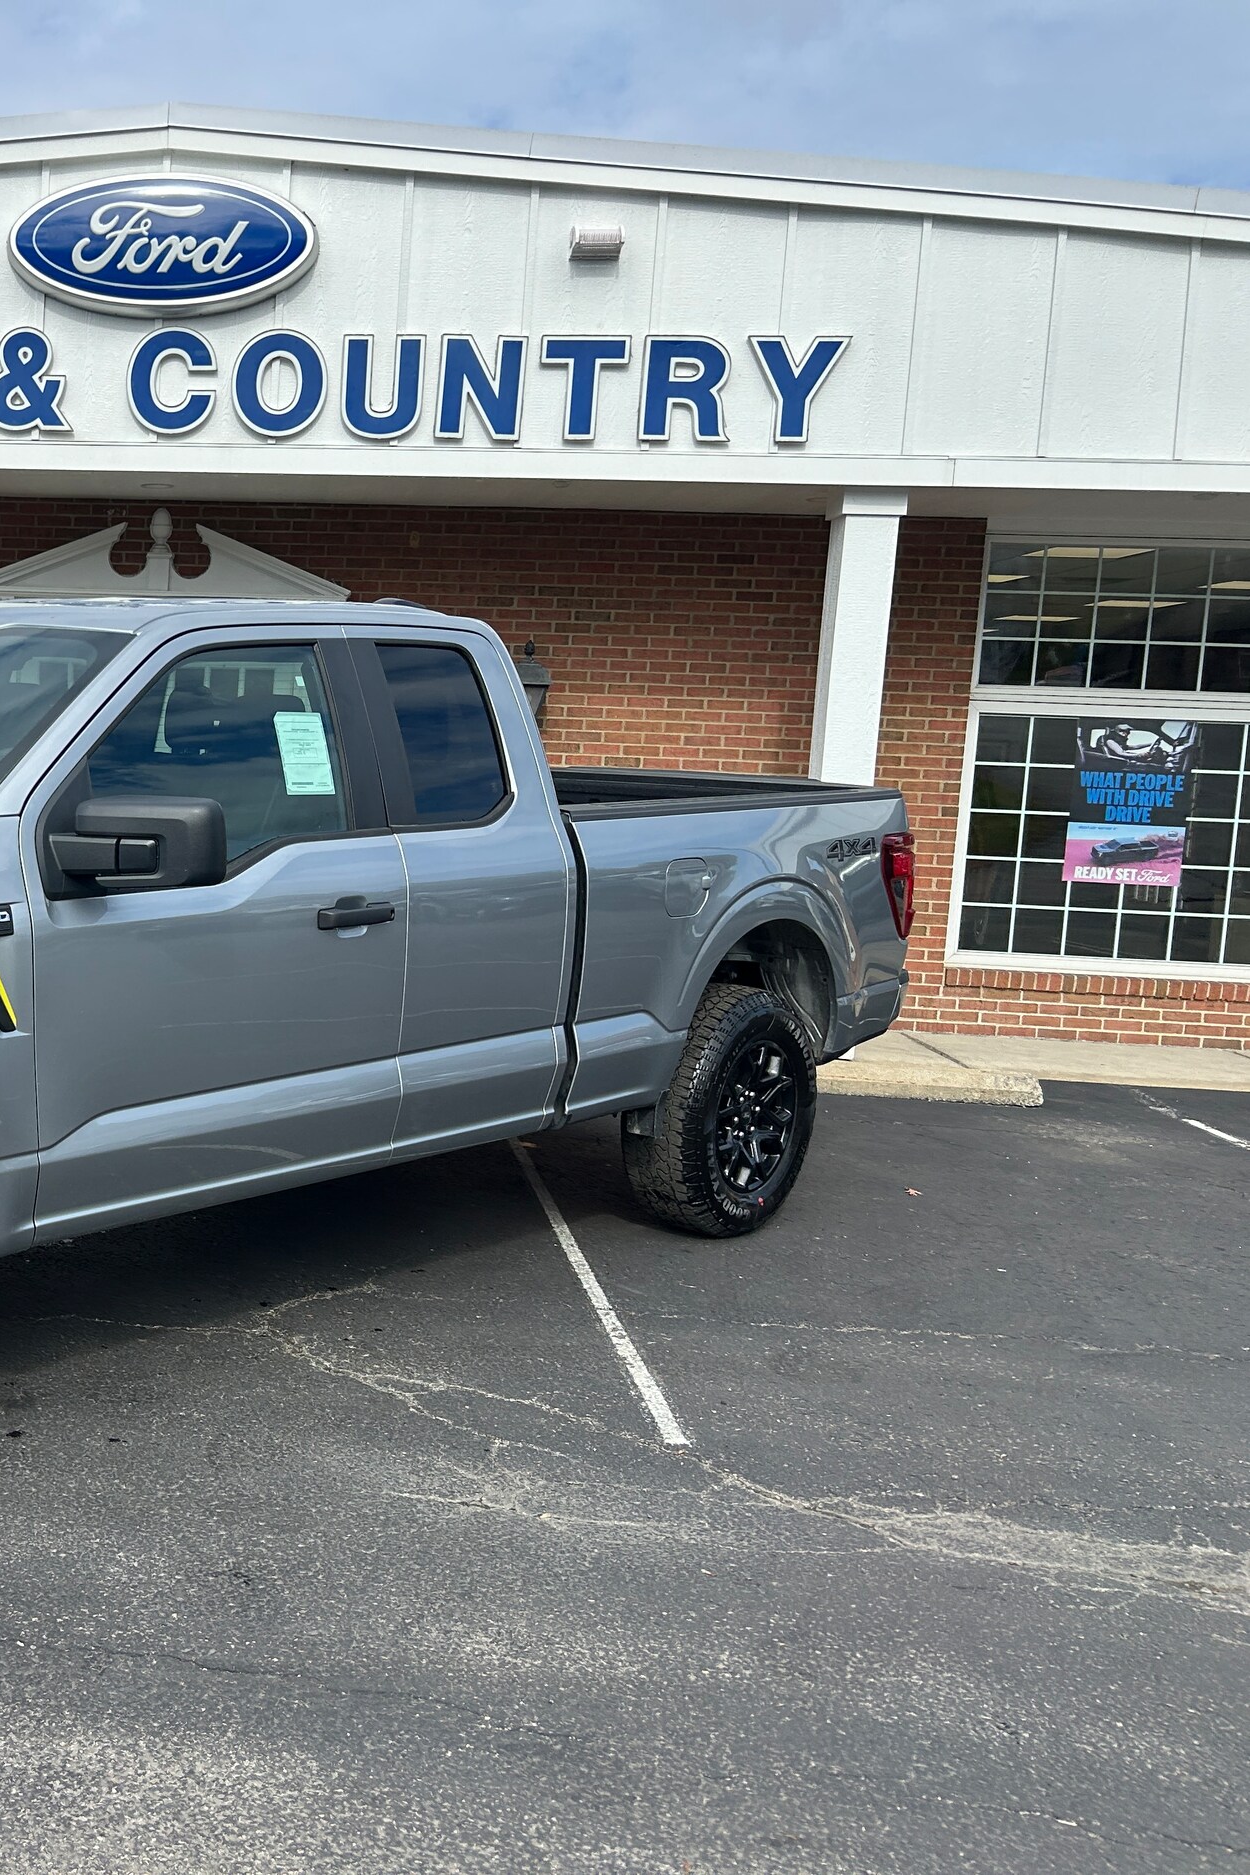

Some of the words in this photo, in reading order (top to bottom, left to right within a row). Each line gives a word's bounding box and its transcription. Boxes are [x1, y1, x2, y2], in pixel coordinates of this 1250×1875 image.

[72, 200, 249, 274] Ford
[127, 326, 853, 444] COUNTRY
[1080, 770, 1123, 788] WHAT
[1125, 773, 1185, 792] PEOPLE
[1086, 787, 1126, 805] WITH
[1127, 789, 1175, 808] DRIVE
[1105, 805, 1152, 823] DRIVE
[1073, 865, 1115, 880] READY
[1115, 867, 1138, 882] SET
[1137, 869, 1172, 883] Ford
